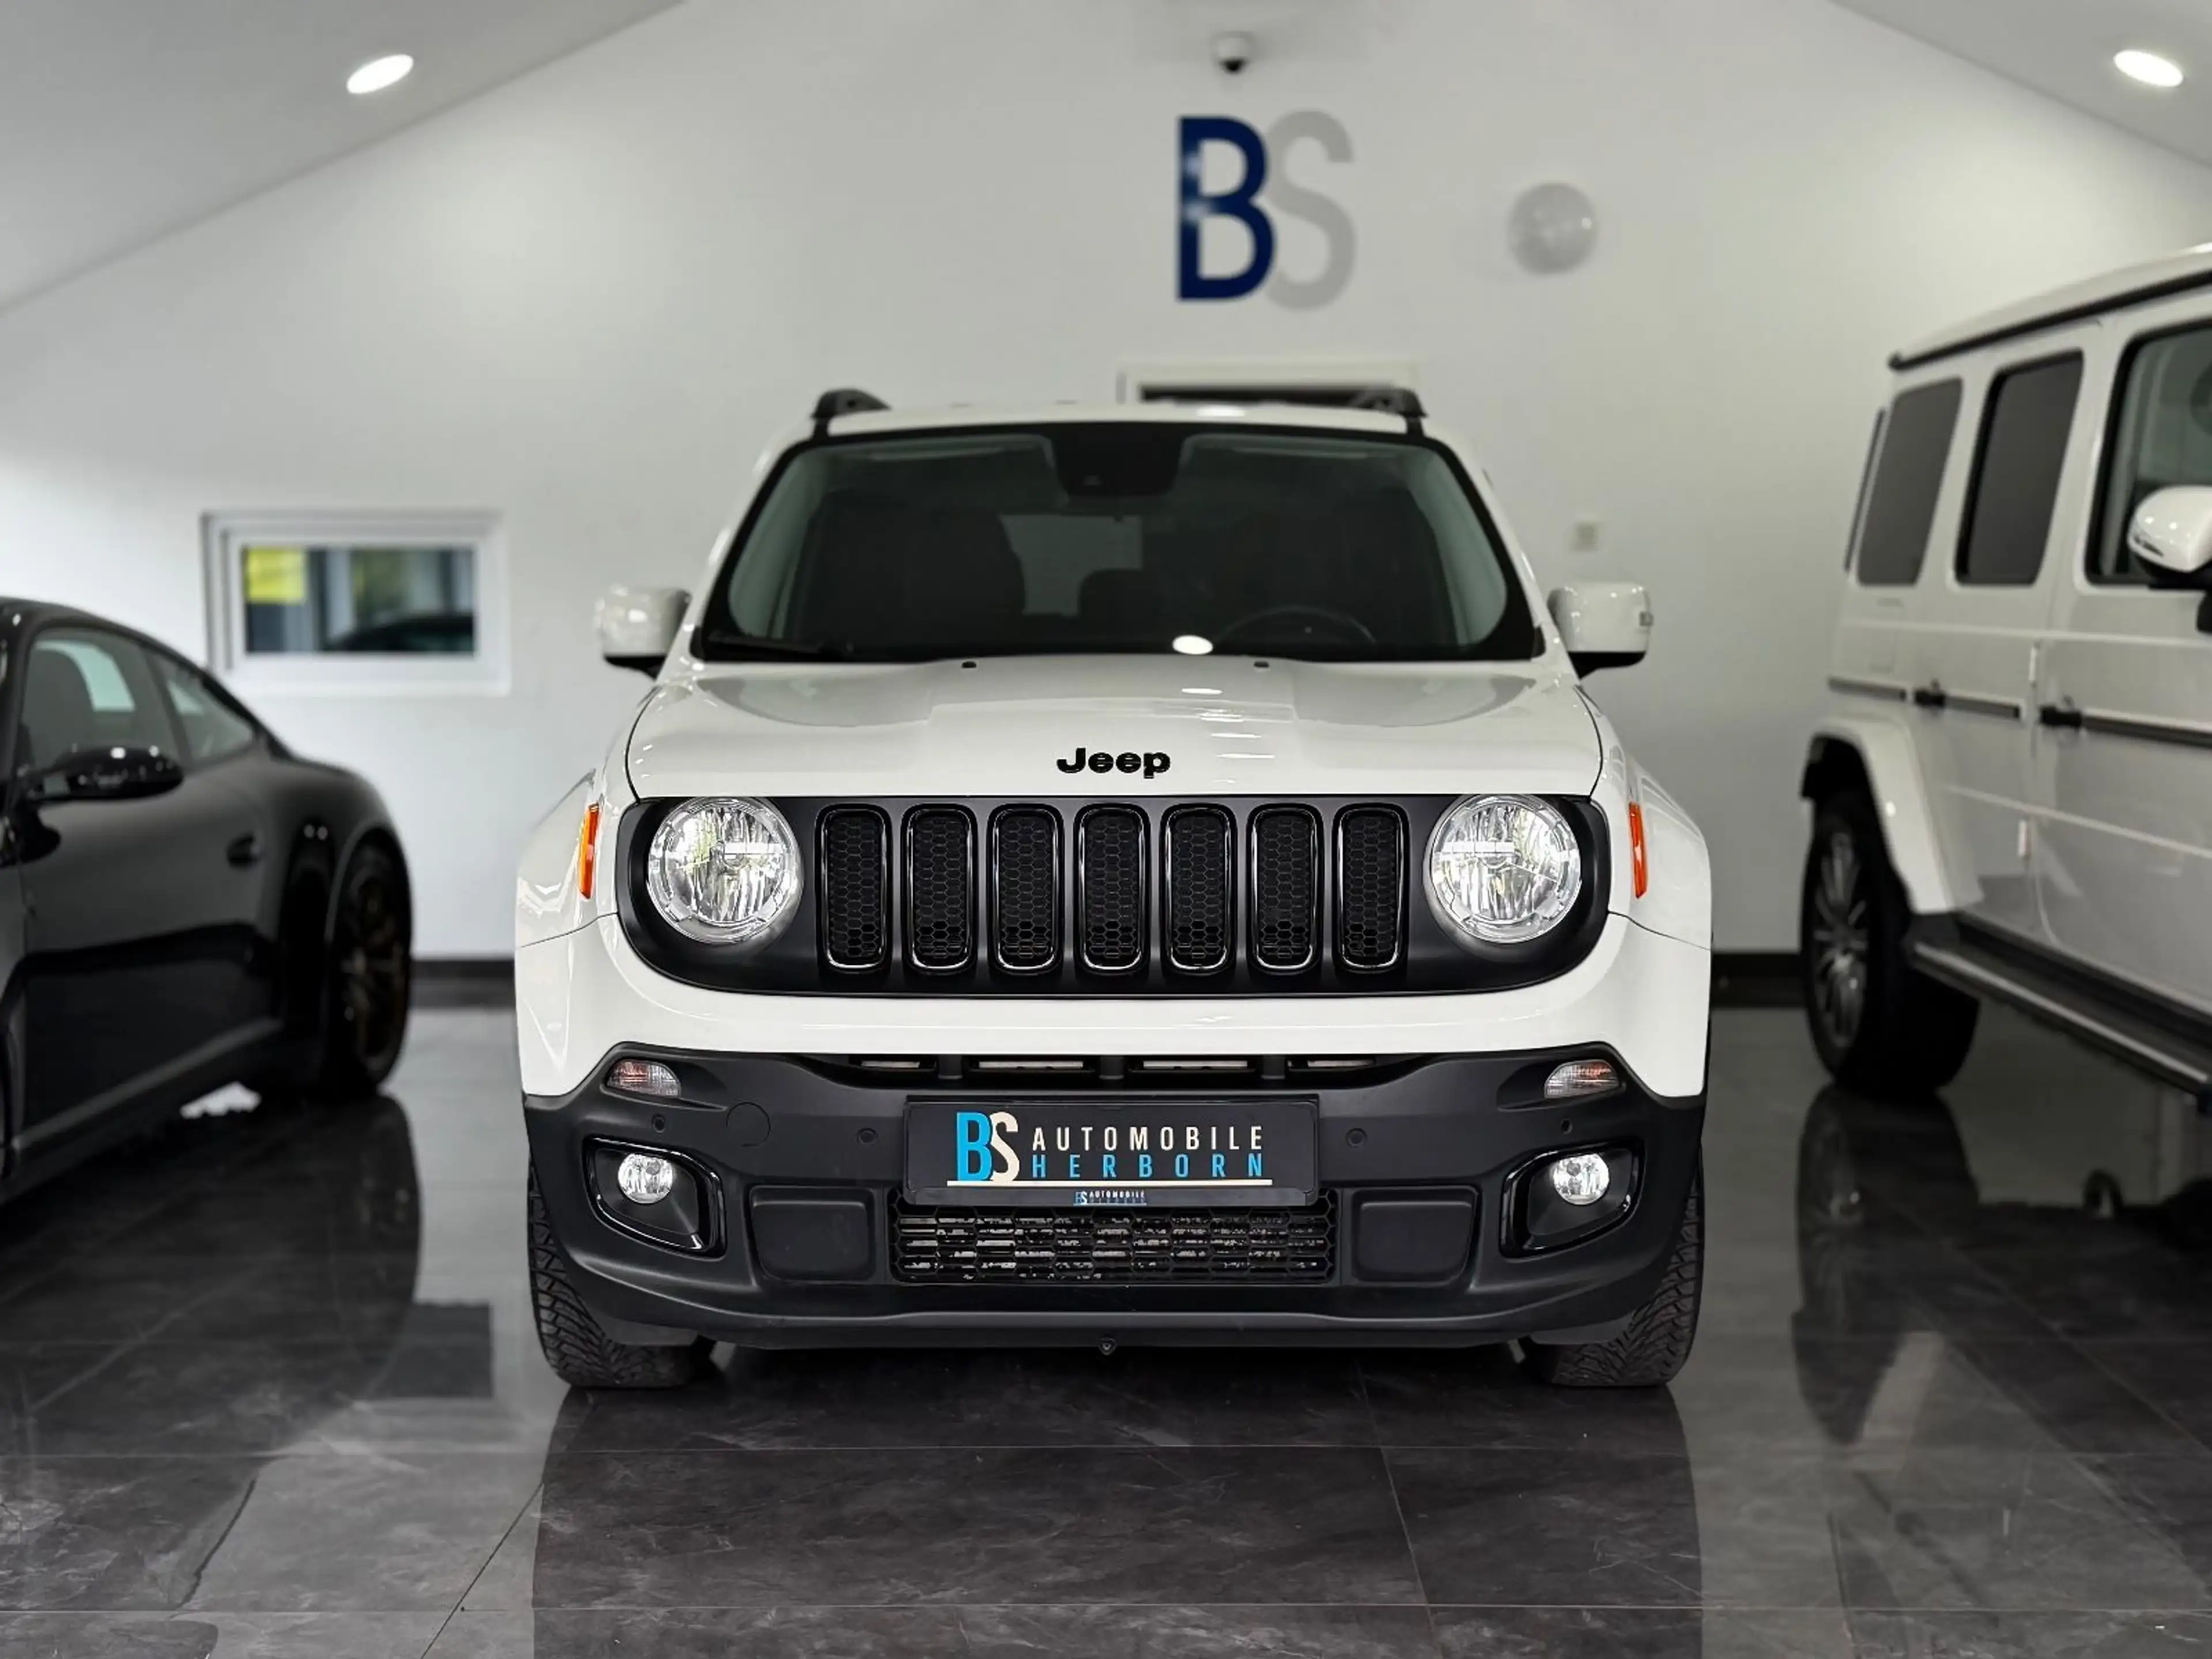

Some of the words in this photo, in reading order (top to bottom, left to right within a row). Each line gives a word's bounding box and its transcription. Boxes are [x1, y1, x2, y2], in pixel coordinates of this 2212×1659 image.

[1177, 111, 1357, 309] BS
[1056, 748, 1171, 779] Jeep
[956, 1112, 1020, 1182] BS
[1032, 1126, 1262, 1151] AUTOMOBILE
[1032, 1153, 1262, 1178] HERBORN
